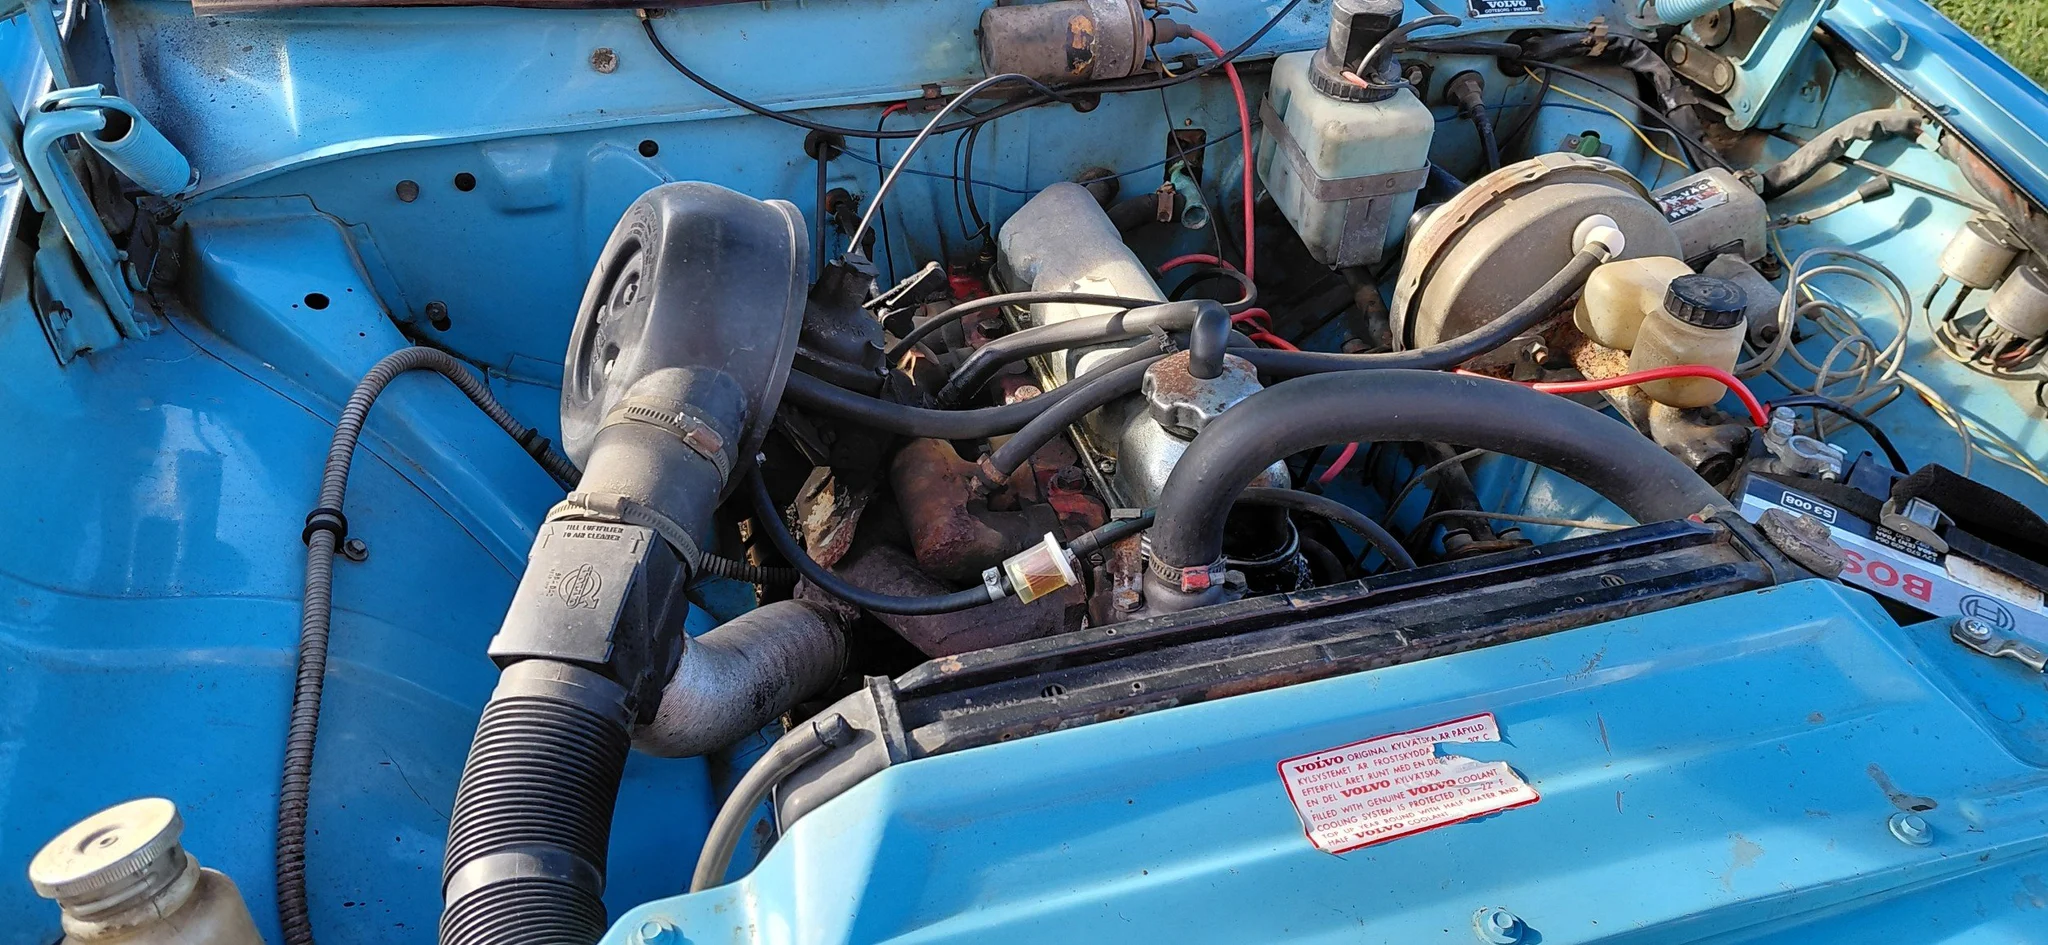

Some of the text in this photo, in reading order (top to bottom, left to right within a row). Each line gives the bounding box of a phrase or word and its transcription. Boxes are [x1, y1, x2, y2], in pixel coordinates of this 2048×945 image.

[1487, 0, 1526, 8] VOLVO
[1786, 495, 1833, 520] S3 008
[1906, 548, 1921, 556] 570
[1843, 549, 1932, 602] BOS
[1294, 756, 1344, 773] VOLVO
[1347, 746, 1388, 761] ORIGINAL
[1298, 767, 1351, 786] KYLSYSTEMET
[1374, 748, 1430, 766] FROSTSKYDDA
[1302, 780, 1342, 797] EFTERFYLL
[1368, 769, 1390, 780] RUNT
[1394, 763, 1411, 773] MED
[1306, 799, 1319, 808] EN
[1323, 794, 1338, 803] DEL
[1340, 780, 1390, 798] VOLVO
[1312, 809, 1337, 821] FILLED
[1341, 802, 1363, 813] WITH
[1368, 792, 1406, 807] GENUINE
[1406, 780, 1456, 797] VOLVO
[1317, 816, 1358, 832] COOLING
[1362, 808, 1393, 820] SYSTEM
[1408, 792, 1454, 809] PROTECTED
[1458, 787, 1470, 796] TO
[1322, 831, 1338, 839] TOP
[1358, 821, 1379, 830] YEAR
[1384, 812, 1415, 824] ROUND
[1419, 806, 1440, 815] WITH
[1443, 800, 1464, 808] HALF
[1467, 792, 1496, 803] WATER
[1498, 787, 1518, 795] AND
[1327, 836, 1349, 846] HALF
[1354, 823, 1404, 838] VOLVO
